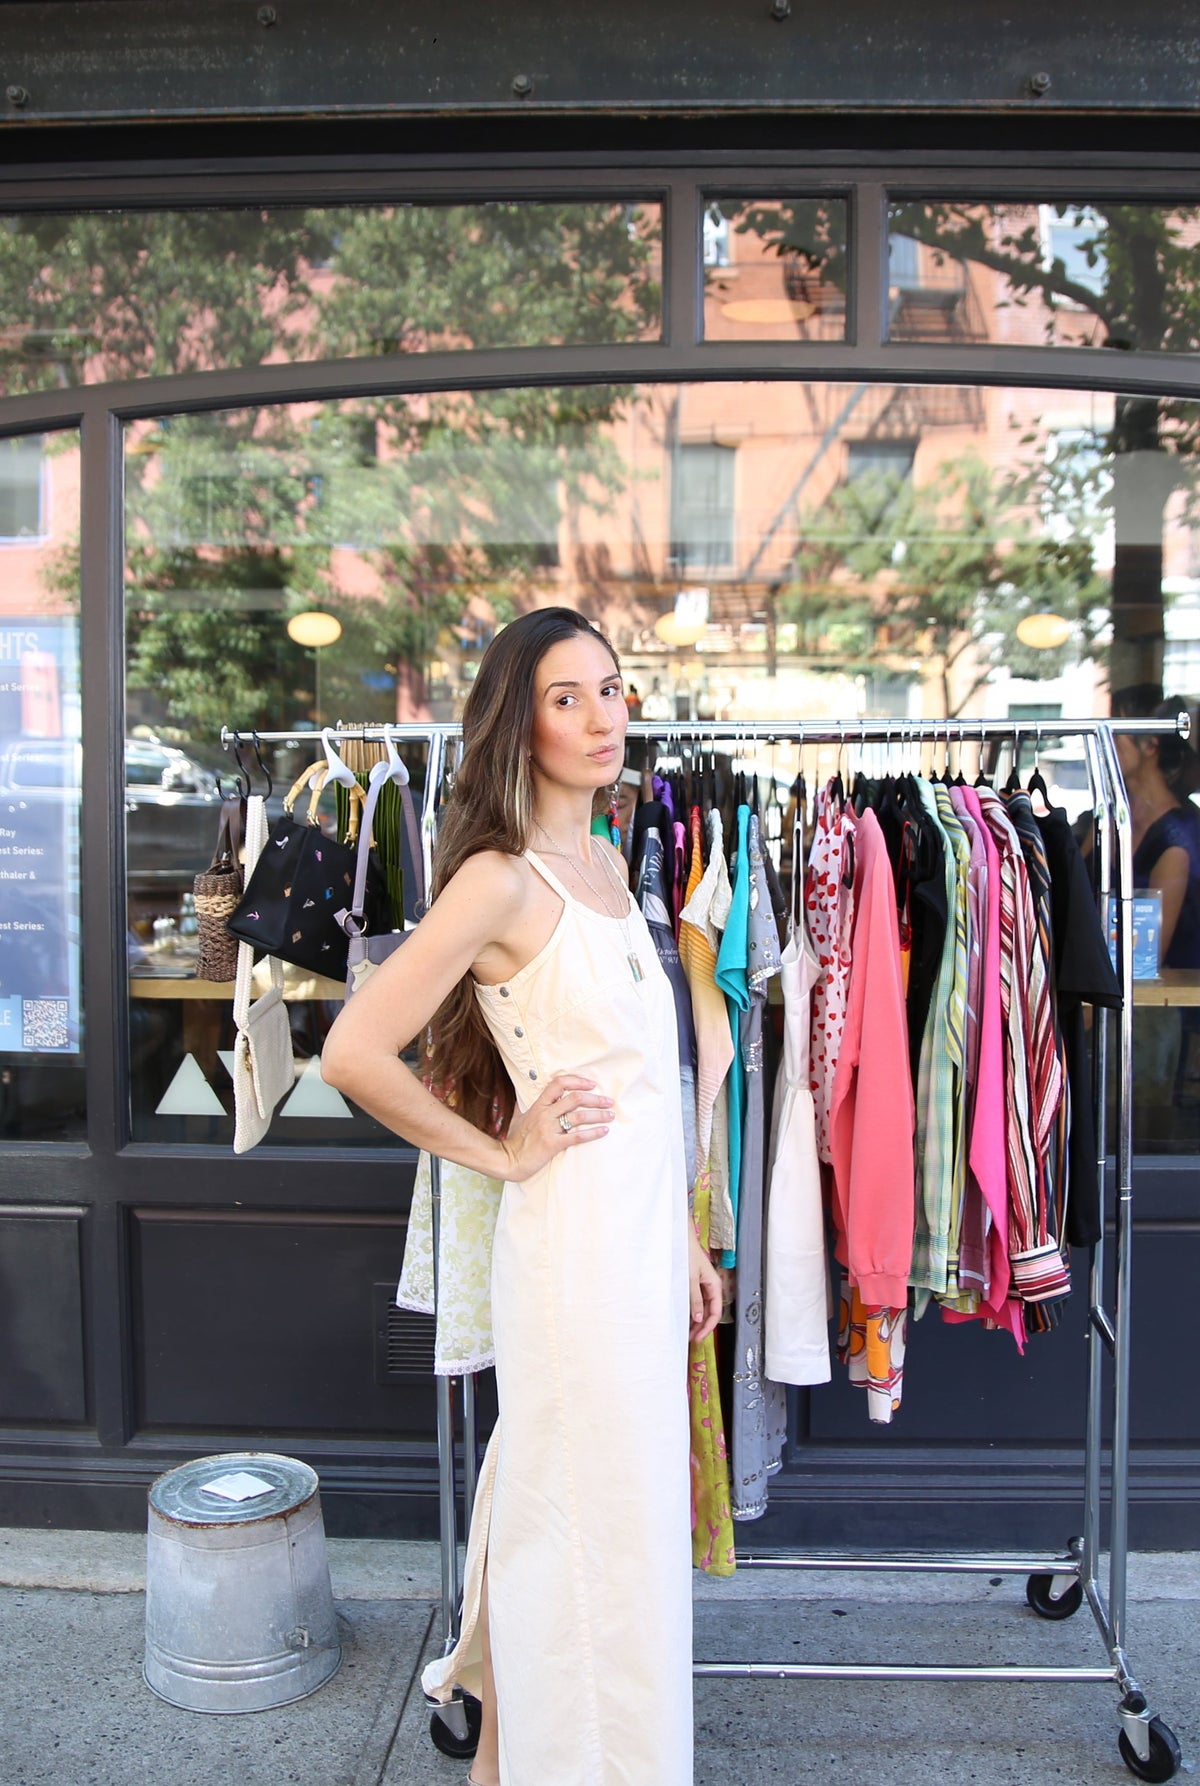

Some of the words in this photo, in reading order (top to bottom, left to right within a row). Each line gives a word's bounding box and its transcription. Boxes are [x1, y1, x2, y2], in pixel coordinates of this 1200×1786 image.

[0, 828, 16, 839] Ray
[12, 846, 44, 855] Series:
[13, 921, 45, 930] Series:
